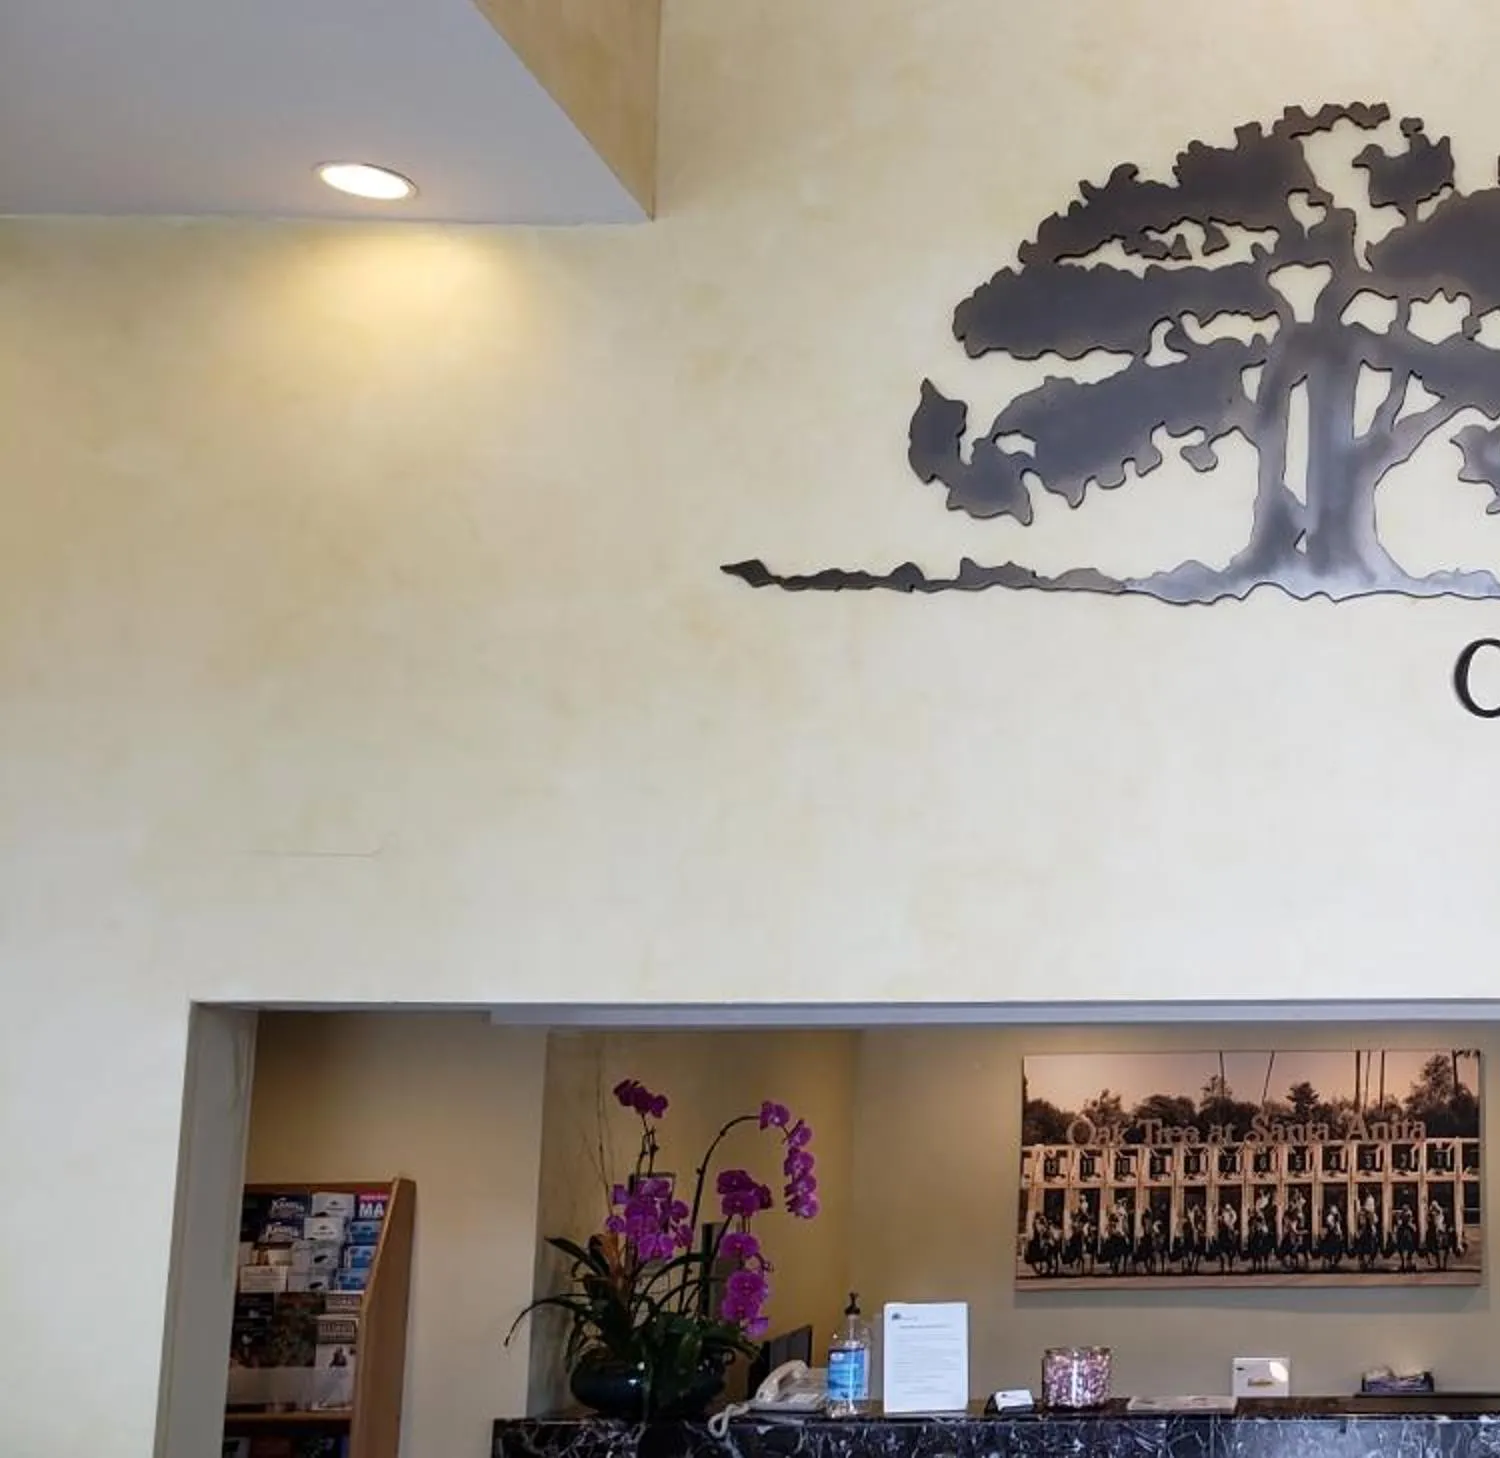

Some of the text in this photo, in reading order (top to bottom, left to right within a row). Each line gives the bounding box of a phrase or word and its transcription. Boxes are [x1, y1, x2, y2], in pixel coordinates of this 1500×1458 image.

[1067, 1112, 1426, 1146] Oak Tree at Santa Anita
